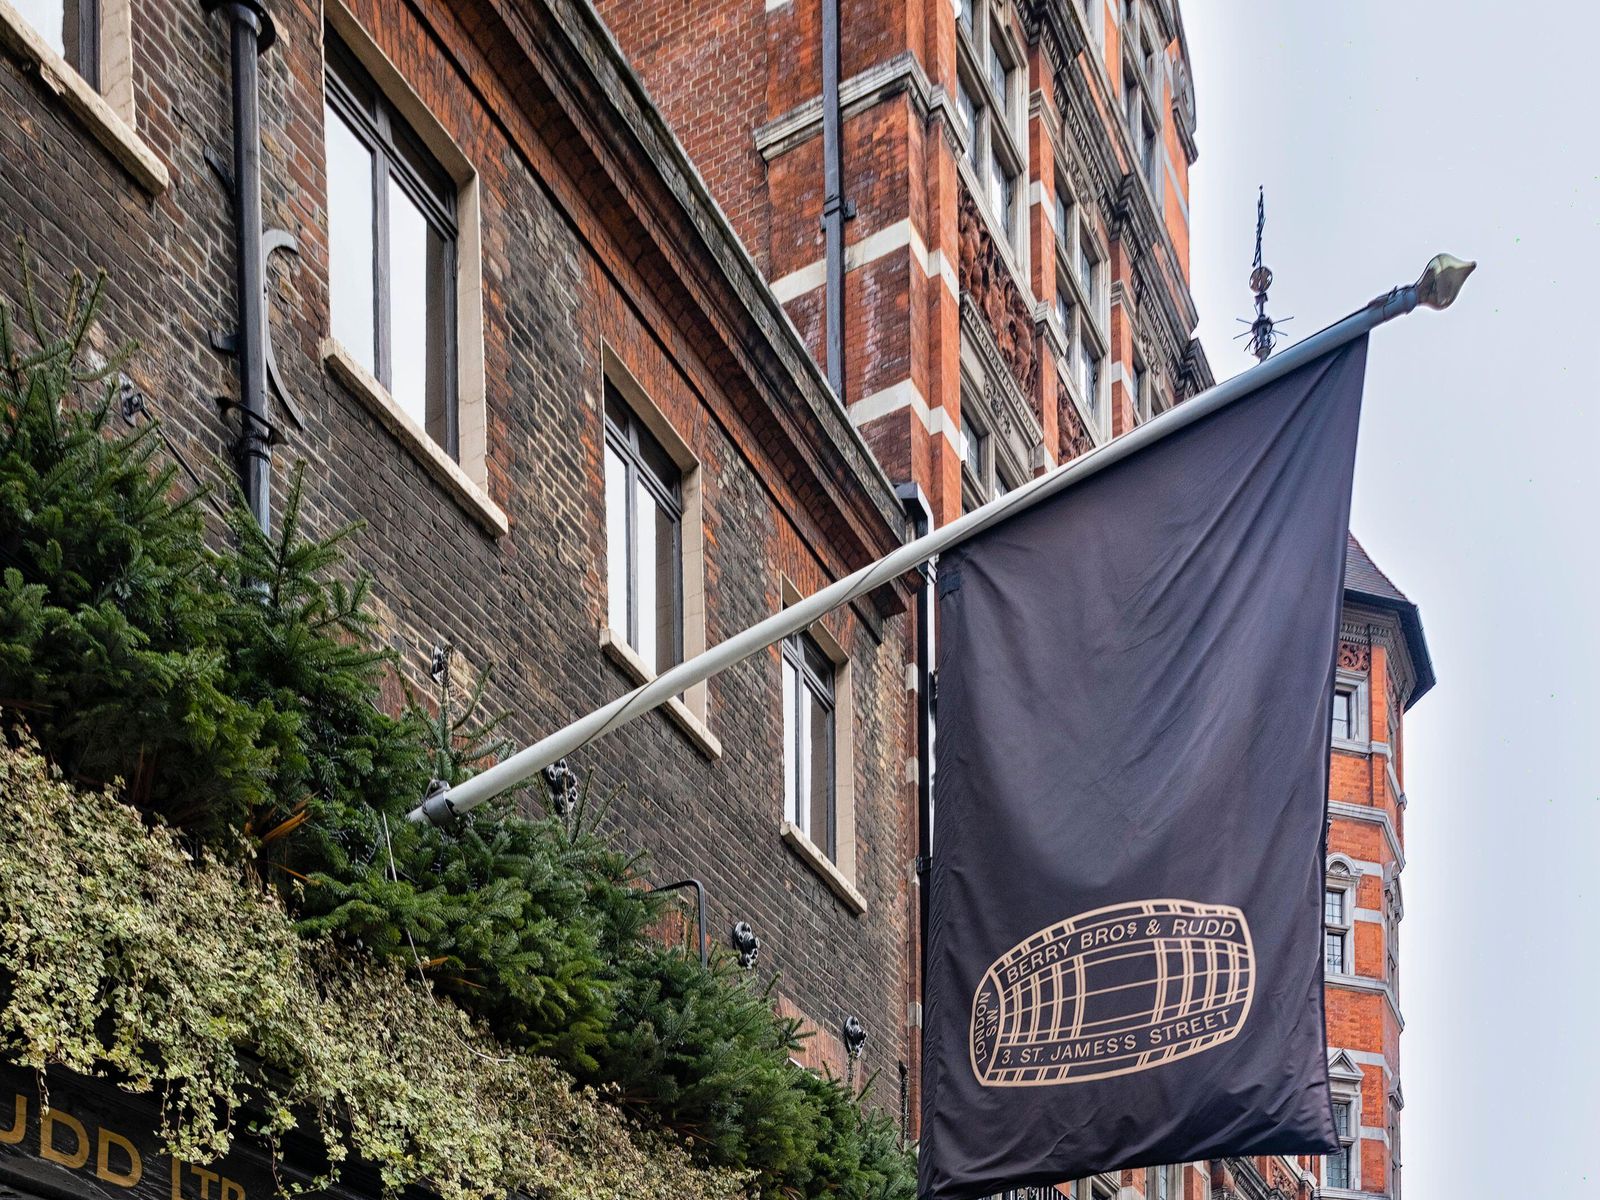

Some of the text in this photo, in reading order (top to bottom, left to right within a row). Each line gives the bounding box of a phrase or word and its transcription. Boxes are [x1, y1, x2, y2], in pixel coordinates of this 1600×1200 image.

[1006, 938, 1073, 984] BERRY
[1145, 919, 1161, 936] &
[1172, 918, 1237, 938] RUDD
[974, 991, 992, 1064] LONDON
[1020, 1046, 1045, 1063] ST.
[1050, 1034, 1137, 1062] JAMES'S
[1149, 1009, 1231, 1045] STREET
